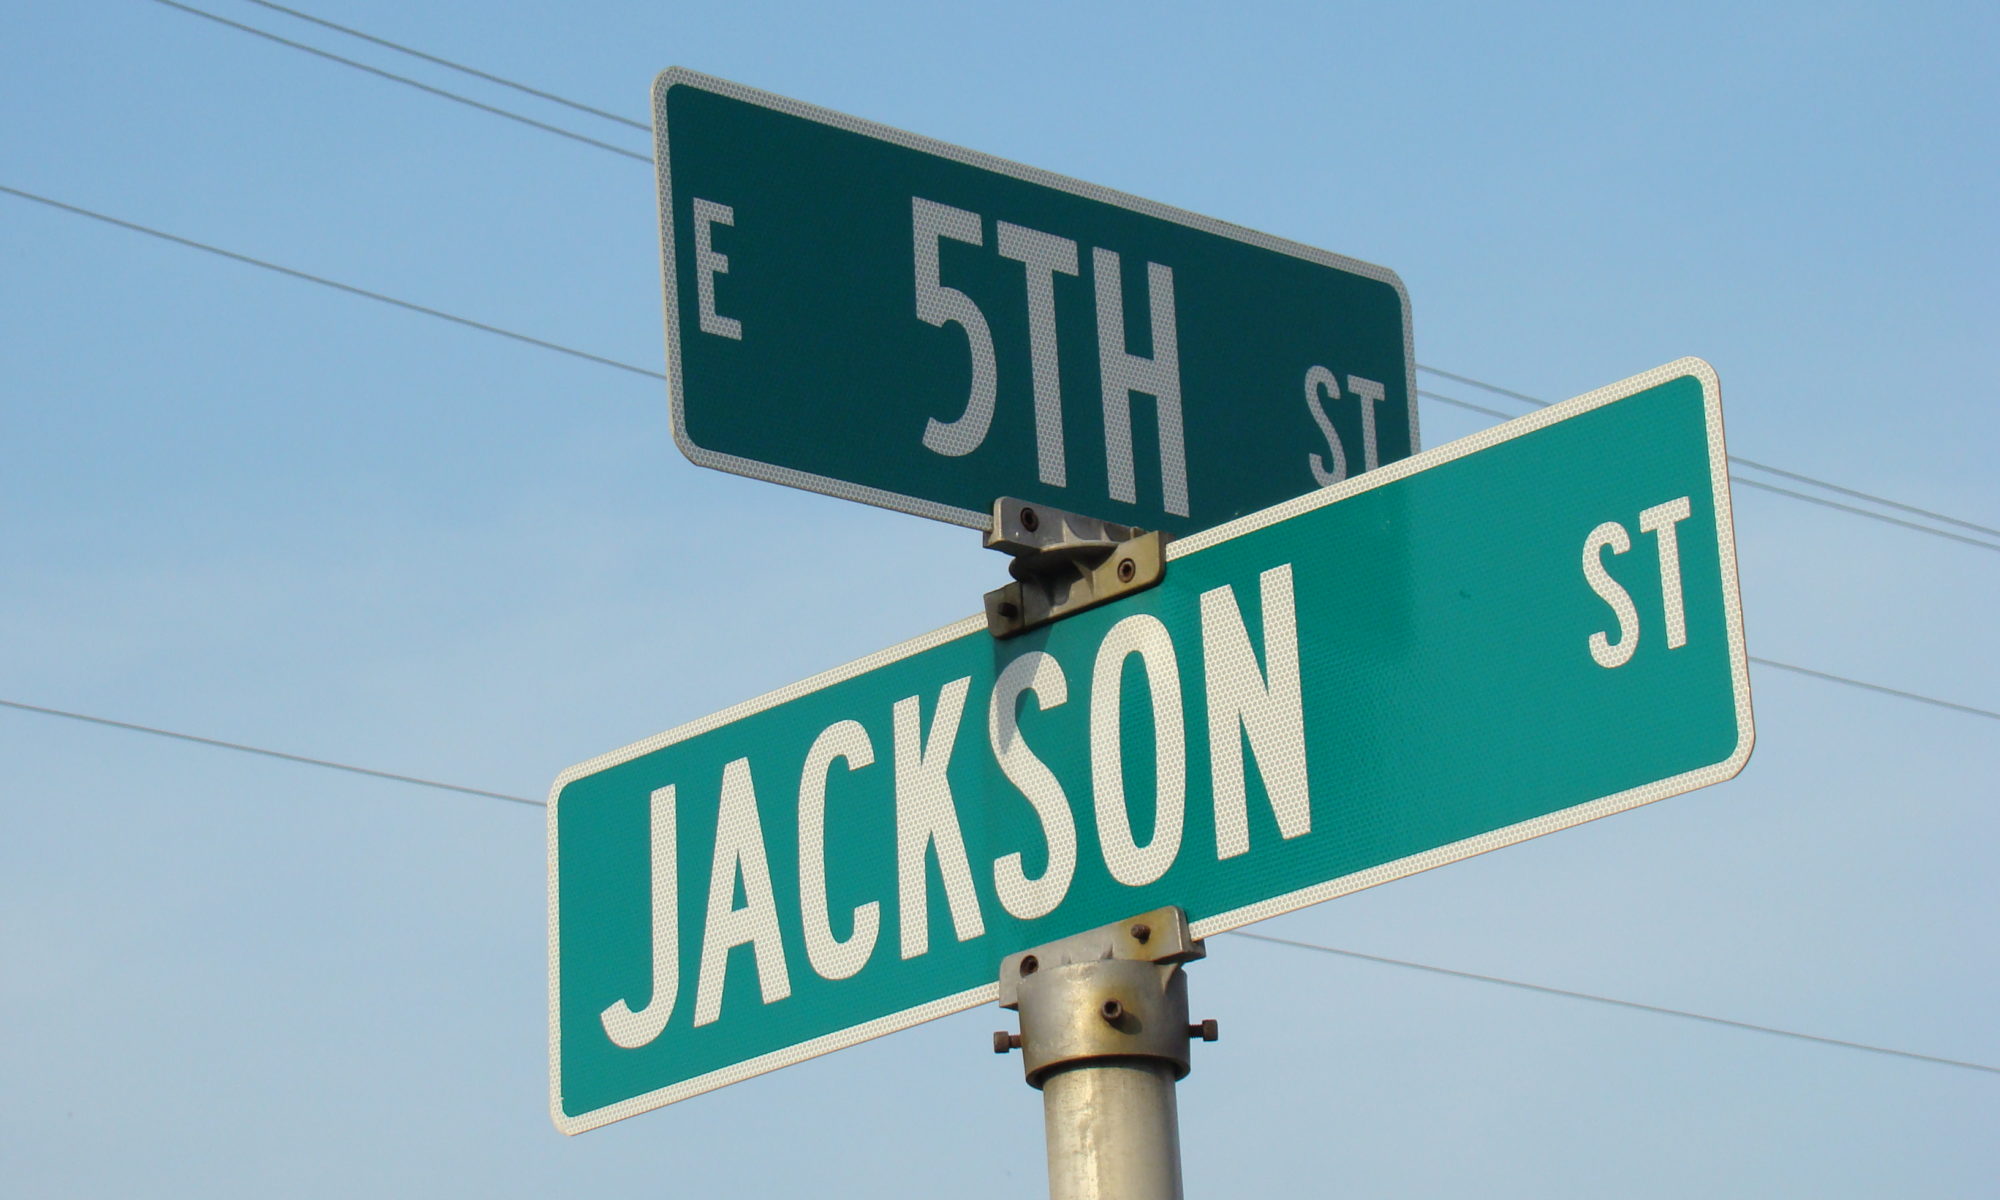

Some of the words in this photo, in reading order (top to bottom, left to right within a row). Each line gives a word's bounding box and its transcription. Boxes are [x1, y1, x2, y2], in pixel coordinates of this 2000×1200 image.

[693, 196, 742, 341] E
[912, 196, 1190, 518] 5TH
[1304, 365, 1385, 487] ST
[600, 563, 1311, 1049] JACKSON
[1581, 496, 1691, 669] ST
